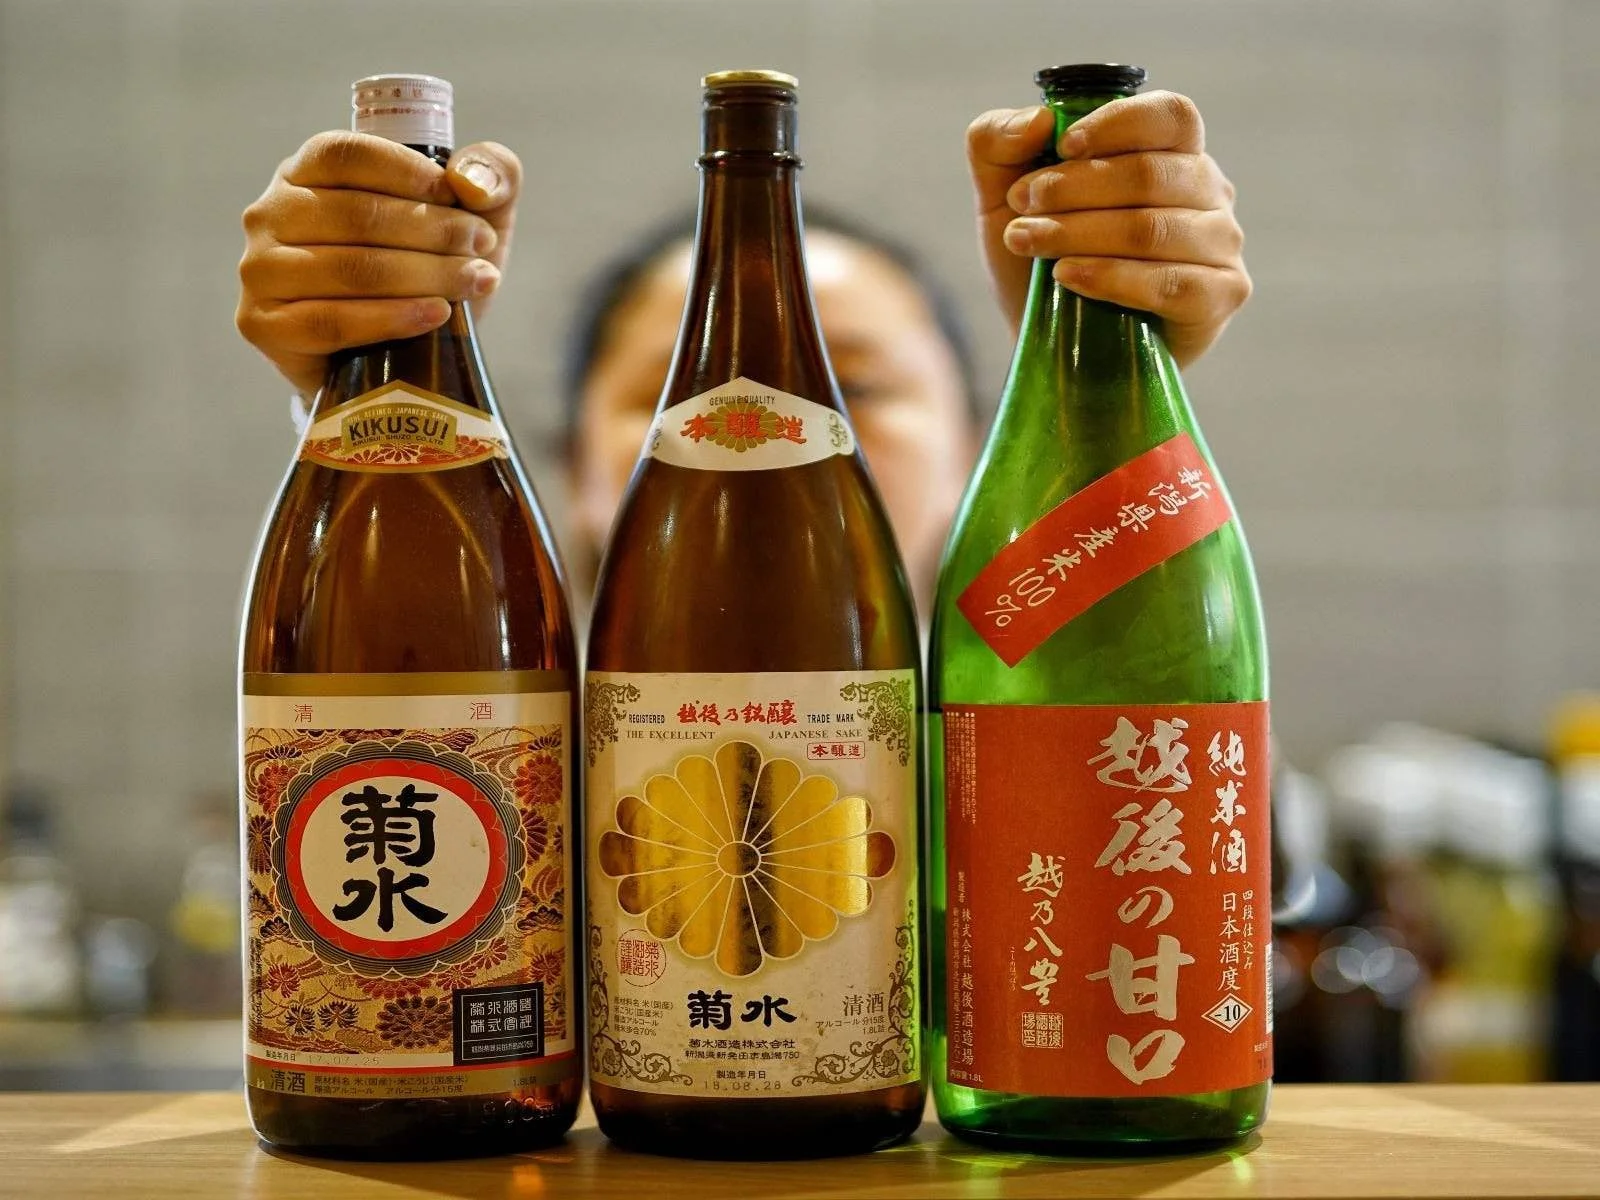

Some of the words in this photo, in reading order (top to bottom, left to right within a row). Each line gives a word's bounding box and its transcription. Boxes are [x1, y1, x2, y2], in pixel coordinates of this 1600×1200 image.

[708, 396, 743, 406] GENUINE
[744, 395, 775, 404] QUALITY
[349, 416, 449, 441] KIKUSUI
[293, 703, 313, 723] 清
[470, 702, 492, 721] 酒
[628, 713, 665, 724] REGISTERED
[807, 713, 831, 724] TRADE
[836, 713, 855, 723] MARK
[626, 729, 646, 739] THE
[649, 730, 716, 740] EXCELLENT
[768, 730, 829, 740] JAPANESE
[835, 728, 863, 738] SAKE
[332, 783, 449, 932] 菊水
[1217, 892, 1241, 991] 日本酒度
[687, 989, 798, 1030] 菊水
[843, 992, 885, 1016] 清酒
[271, 1069, 306, 1094] 清酒
